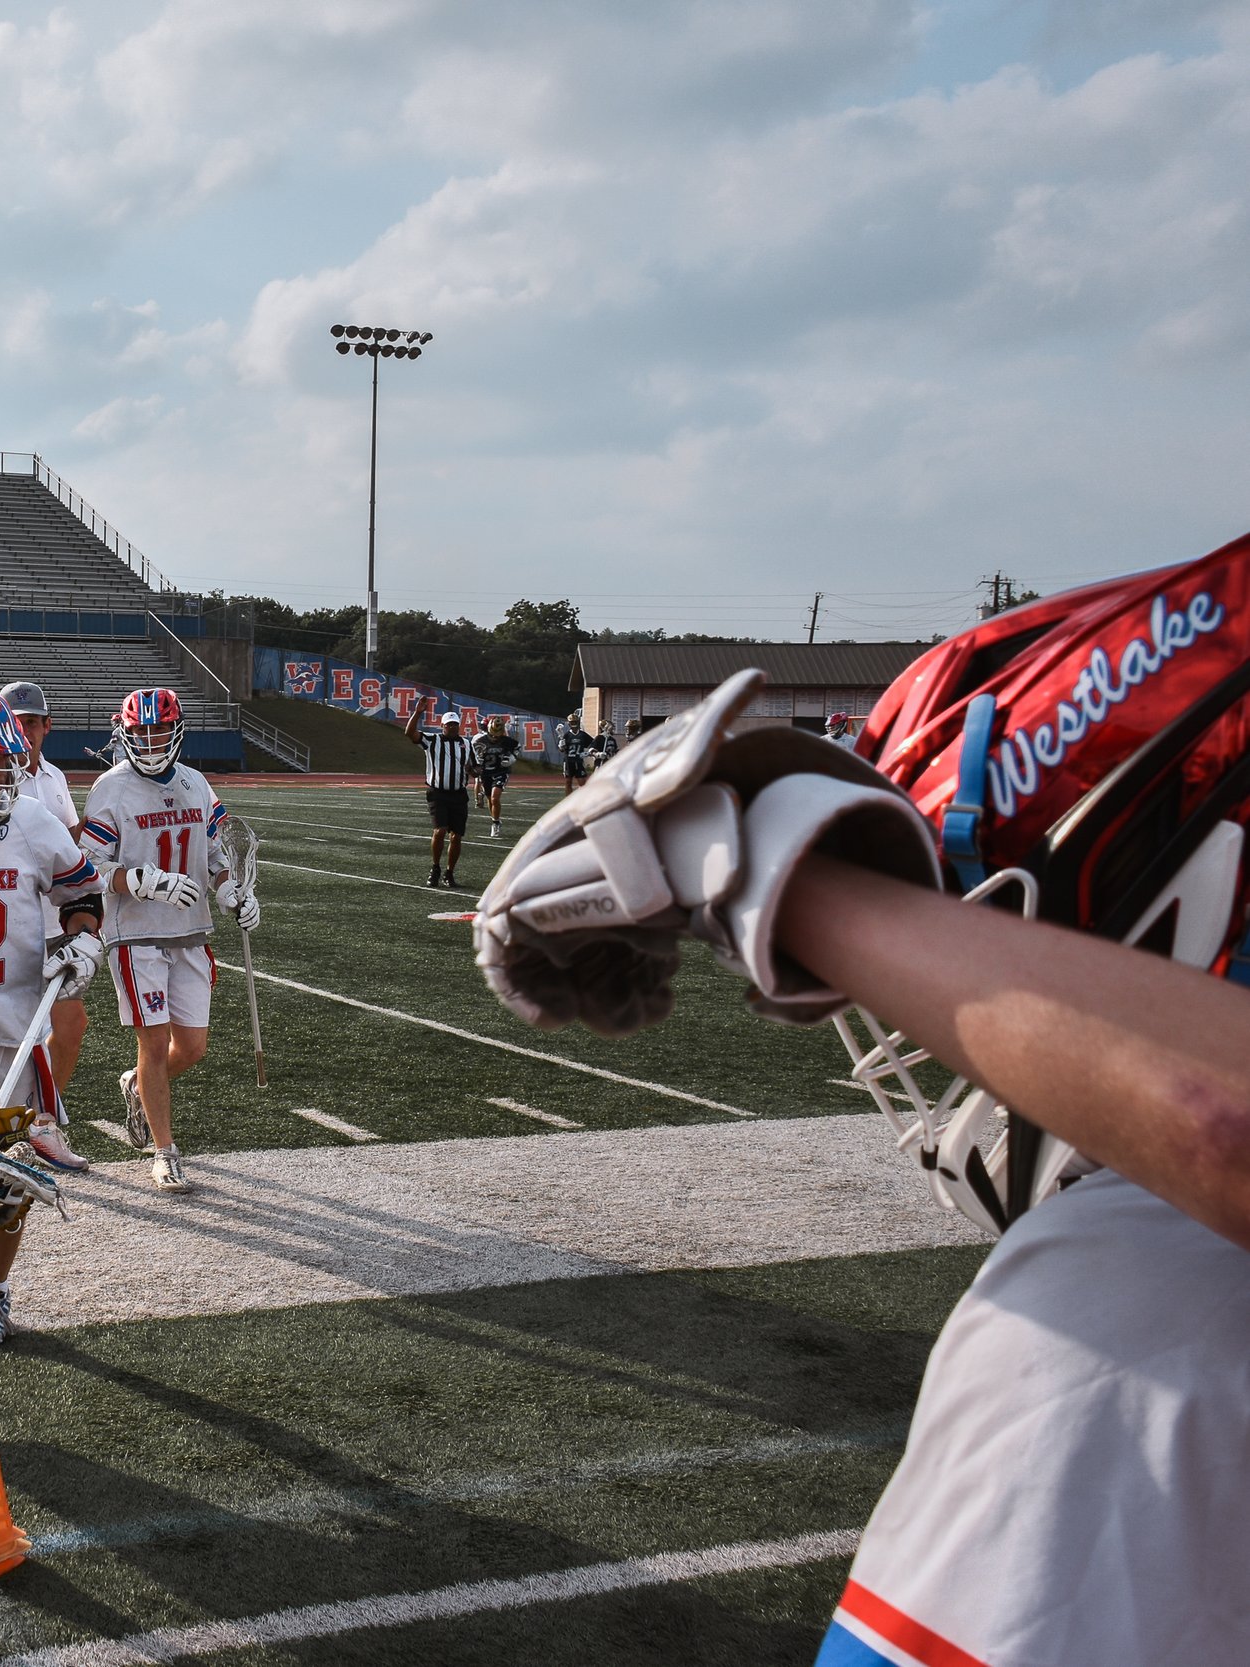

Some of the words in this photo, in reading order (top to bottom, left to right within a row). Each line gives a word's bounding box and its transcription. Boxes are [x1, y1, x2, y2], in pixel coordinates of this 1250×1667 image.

[987, 591, 1225, 819] Westlake
[134, 808, 204, 830] WESTLAKE
[156, 826, 191, 876] 11
